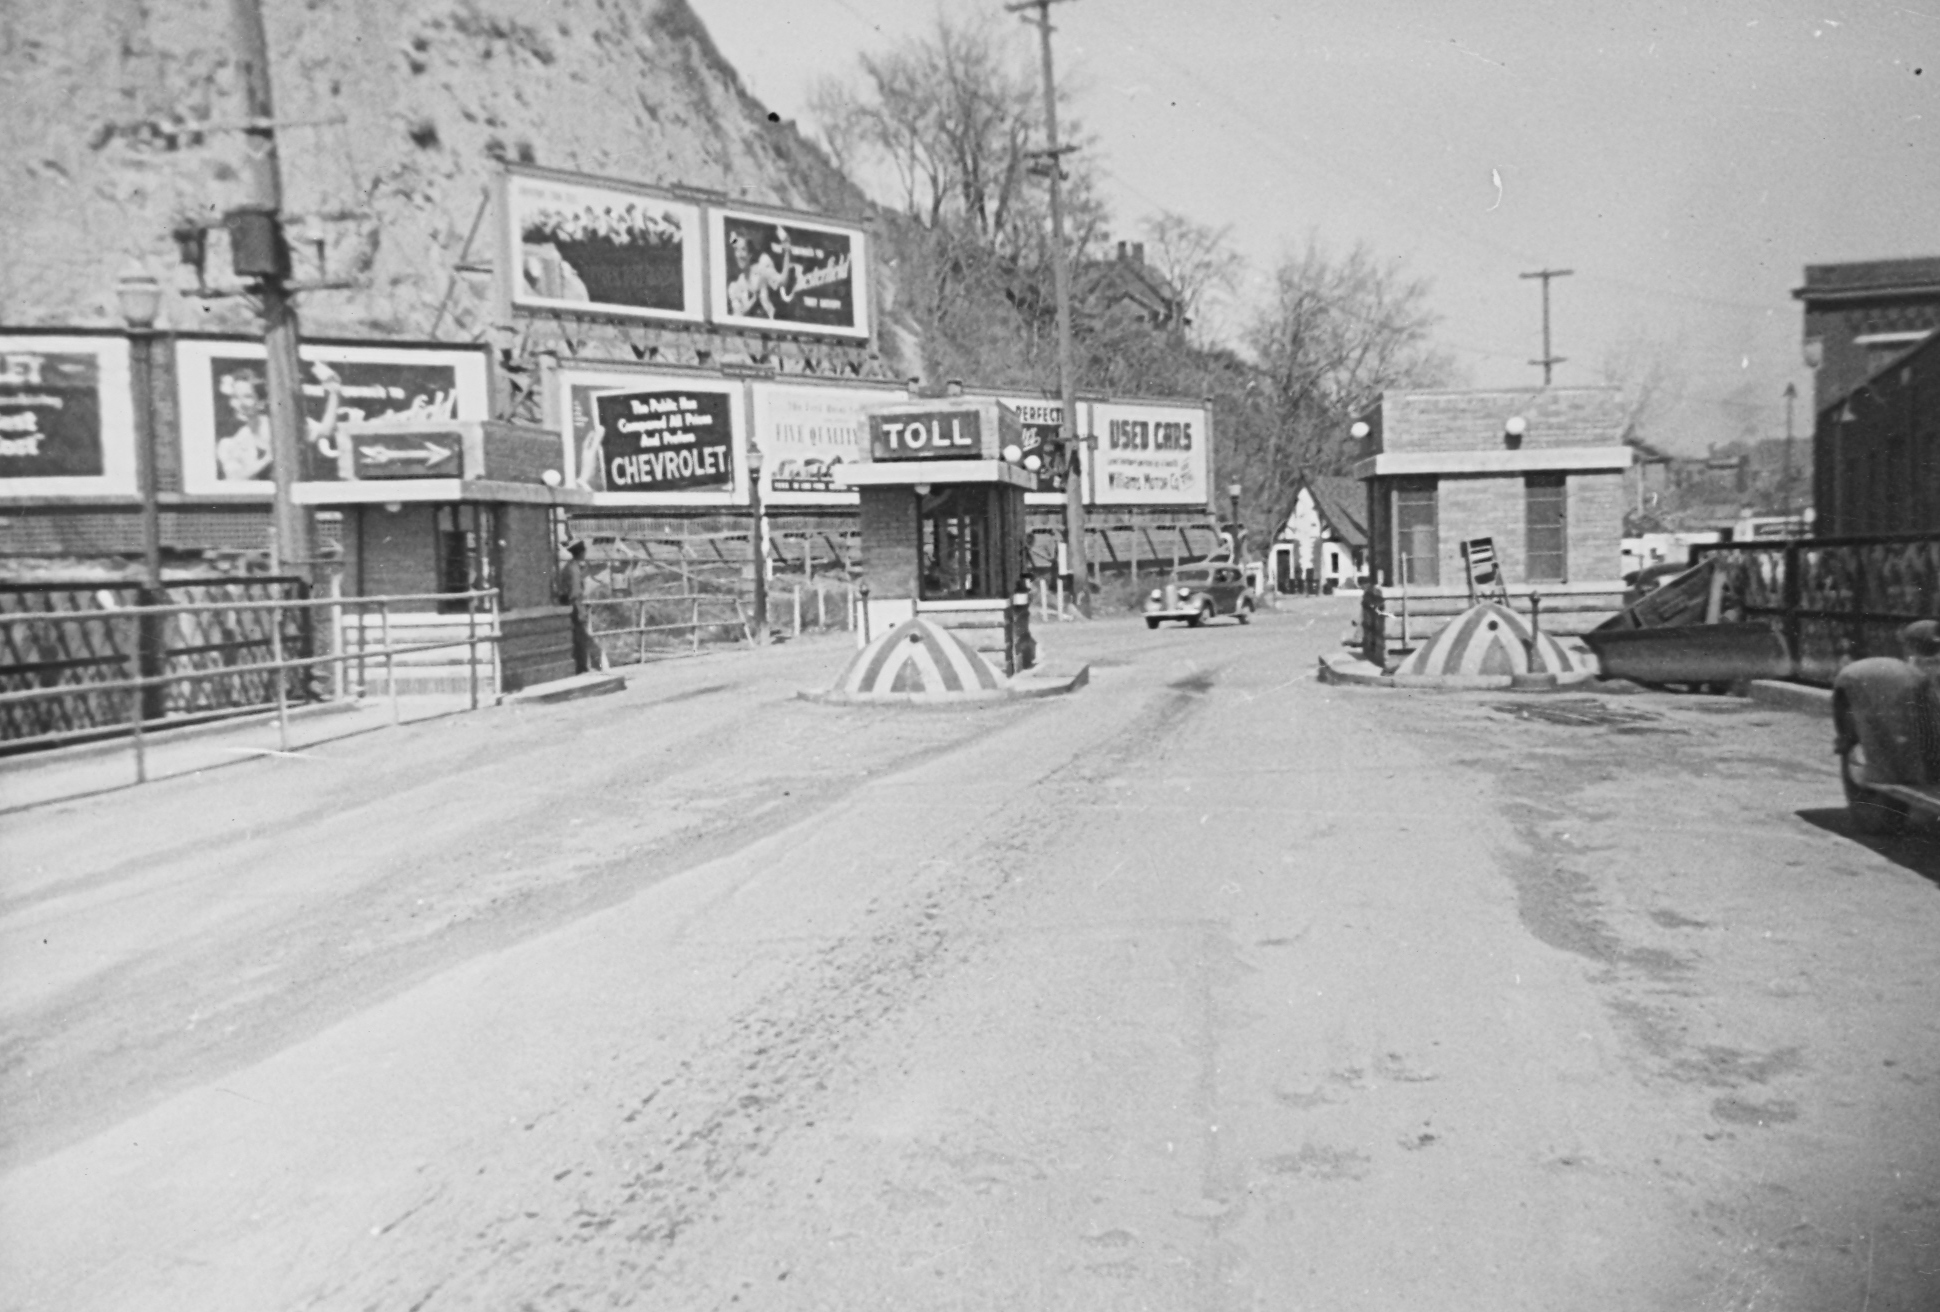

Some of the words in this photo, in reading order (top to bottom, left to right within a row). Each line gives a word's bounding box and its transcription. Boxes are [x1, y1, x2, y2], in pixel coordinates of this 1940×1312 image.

[882, 419, 972, 449] TOLL
[1109, 419, 1149, 450] USED
[1154, 421, 1192, 451] CARS
[611, 445, 727, 486] CHEVROLET
